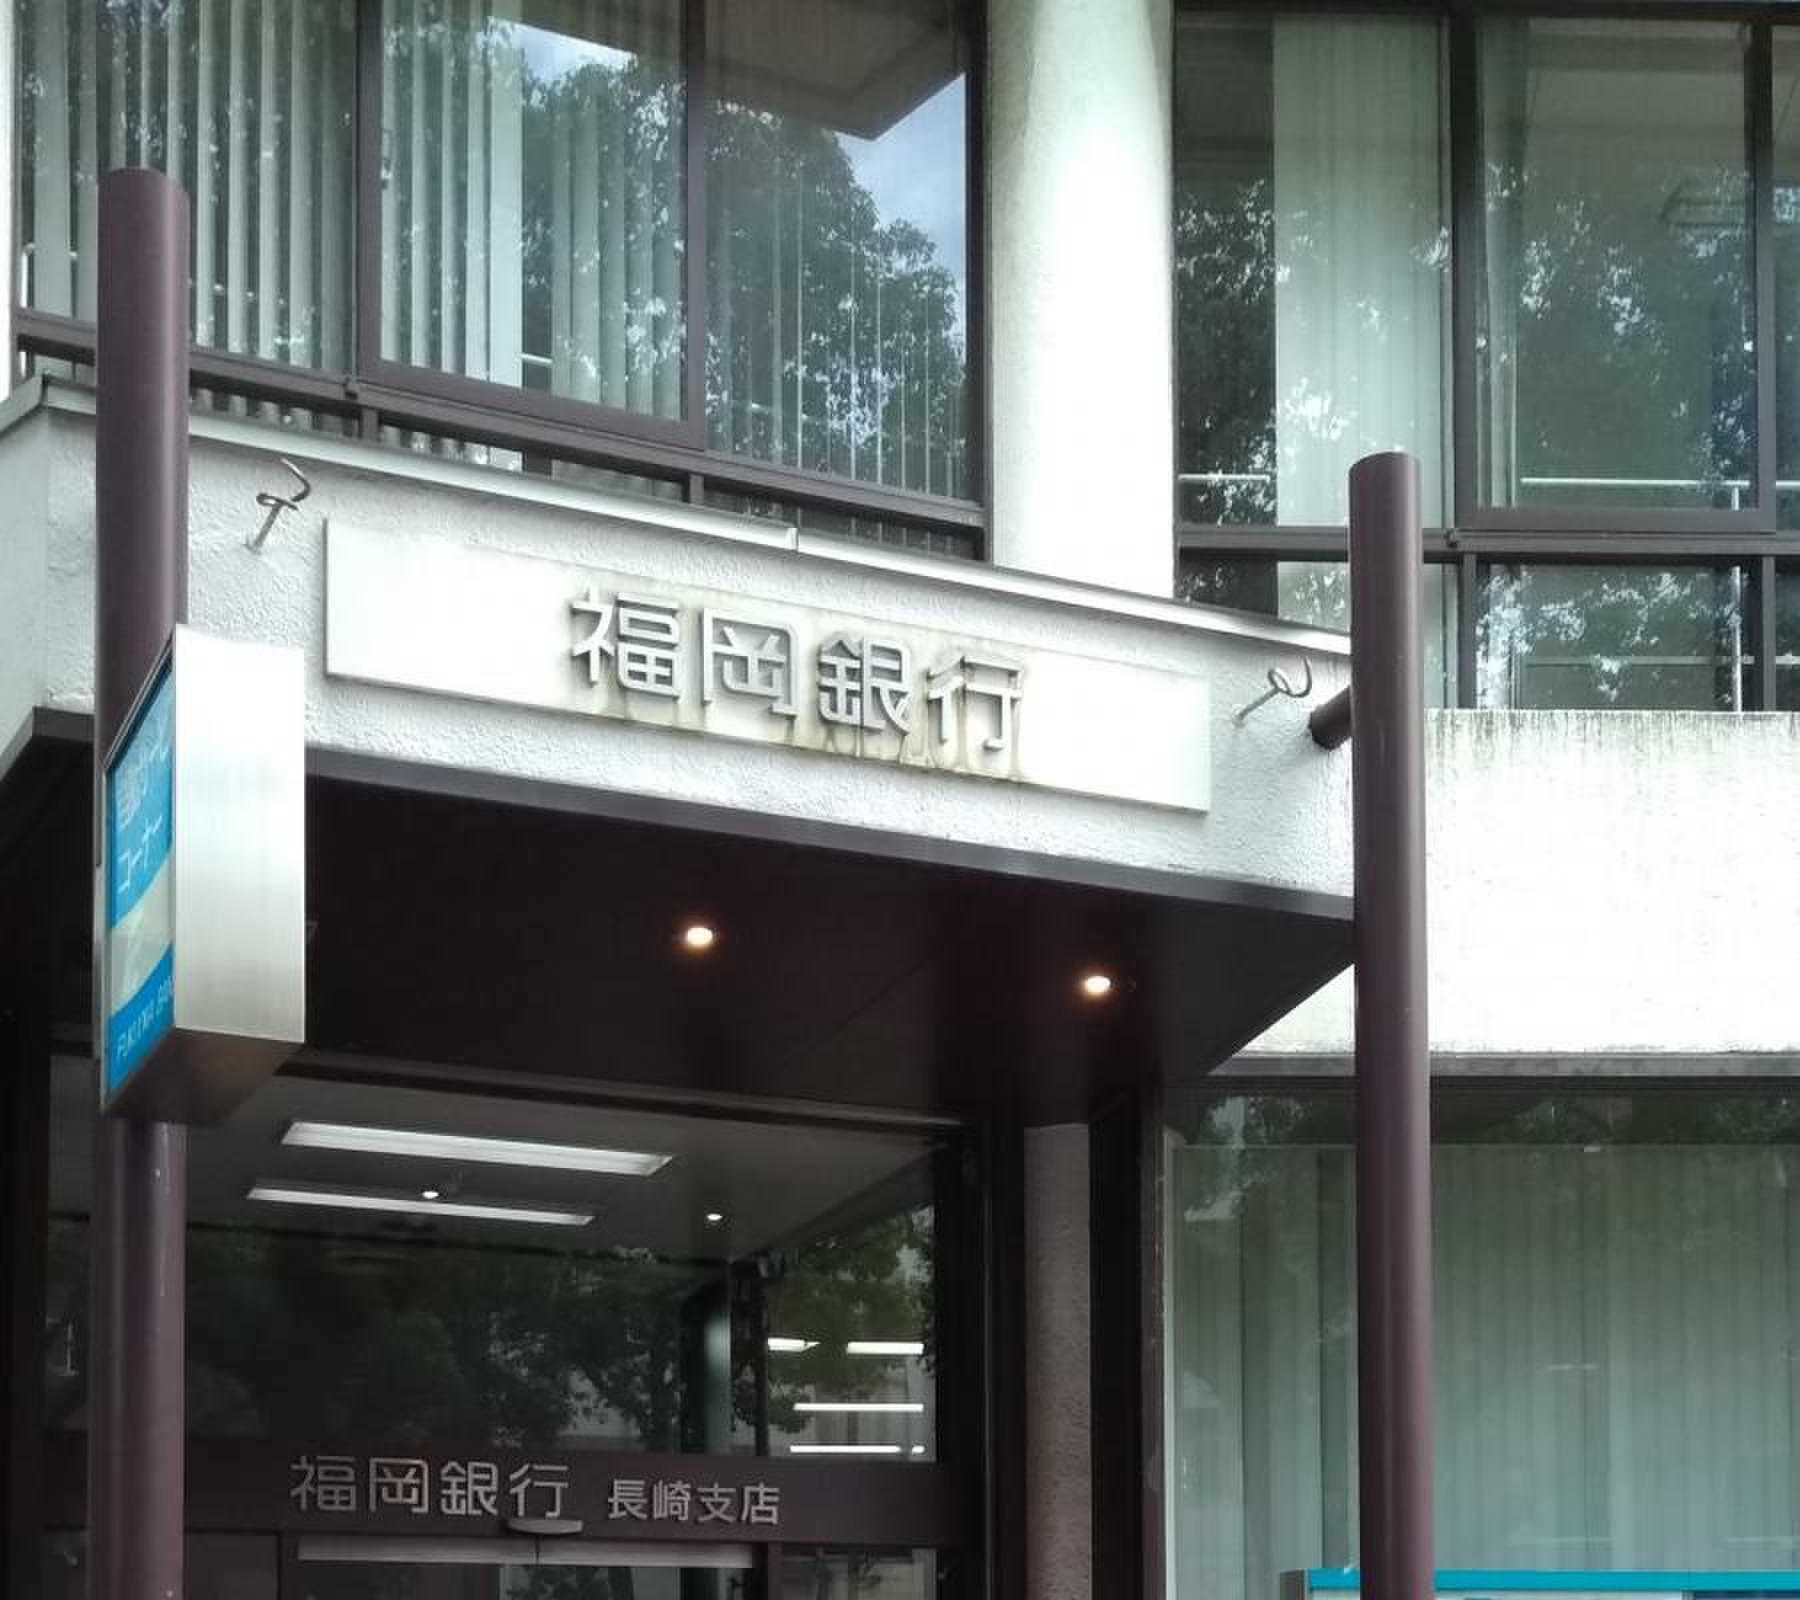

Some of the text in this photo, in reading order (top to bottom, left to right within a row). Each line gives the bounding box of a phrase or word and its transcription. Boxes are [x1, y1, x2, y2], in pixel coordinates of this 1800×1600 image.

[569, 588, 1024, 752] 福岡銀行
[289, 1455, 780, 1525] 福岡銀行 長崎支店
